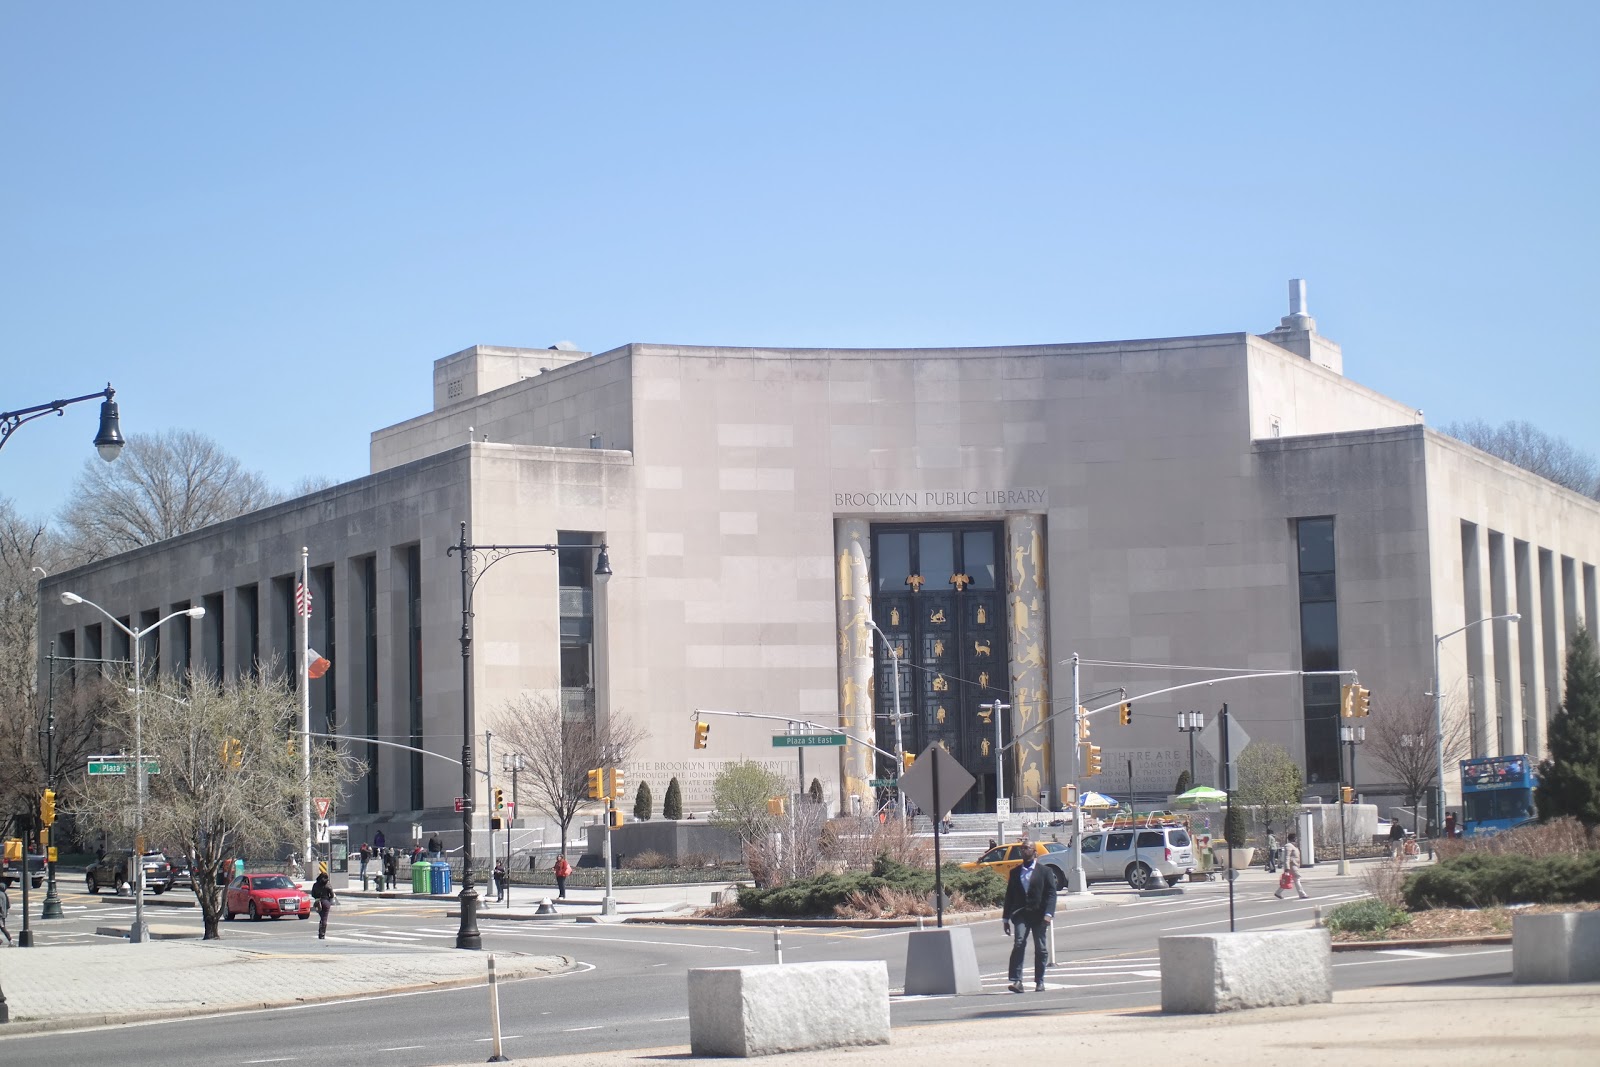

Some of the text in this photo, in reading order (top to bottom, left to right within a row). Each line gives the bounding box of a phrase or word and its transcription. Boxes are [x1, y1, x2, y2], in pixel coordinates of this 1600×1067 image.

[835, 489, 1046, 506] BROOKLYN PUBLIC LIBRARY
[786, 735, 833, 745] Plaza St East
[1118, 751, 1151, 761] HERE
[1156, 750, 1181, 760] ARE
[102, 764, 120, 772] Plaza
[633, 762, 651, 771] THE
[654, 762, 705, 771] BROOKLYN
